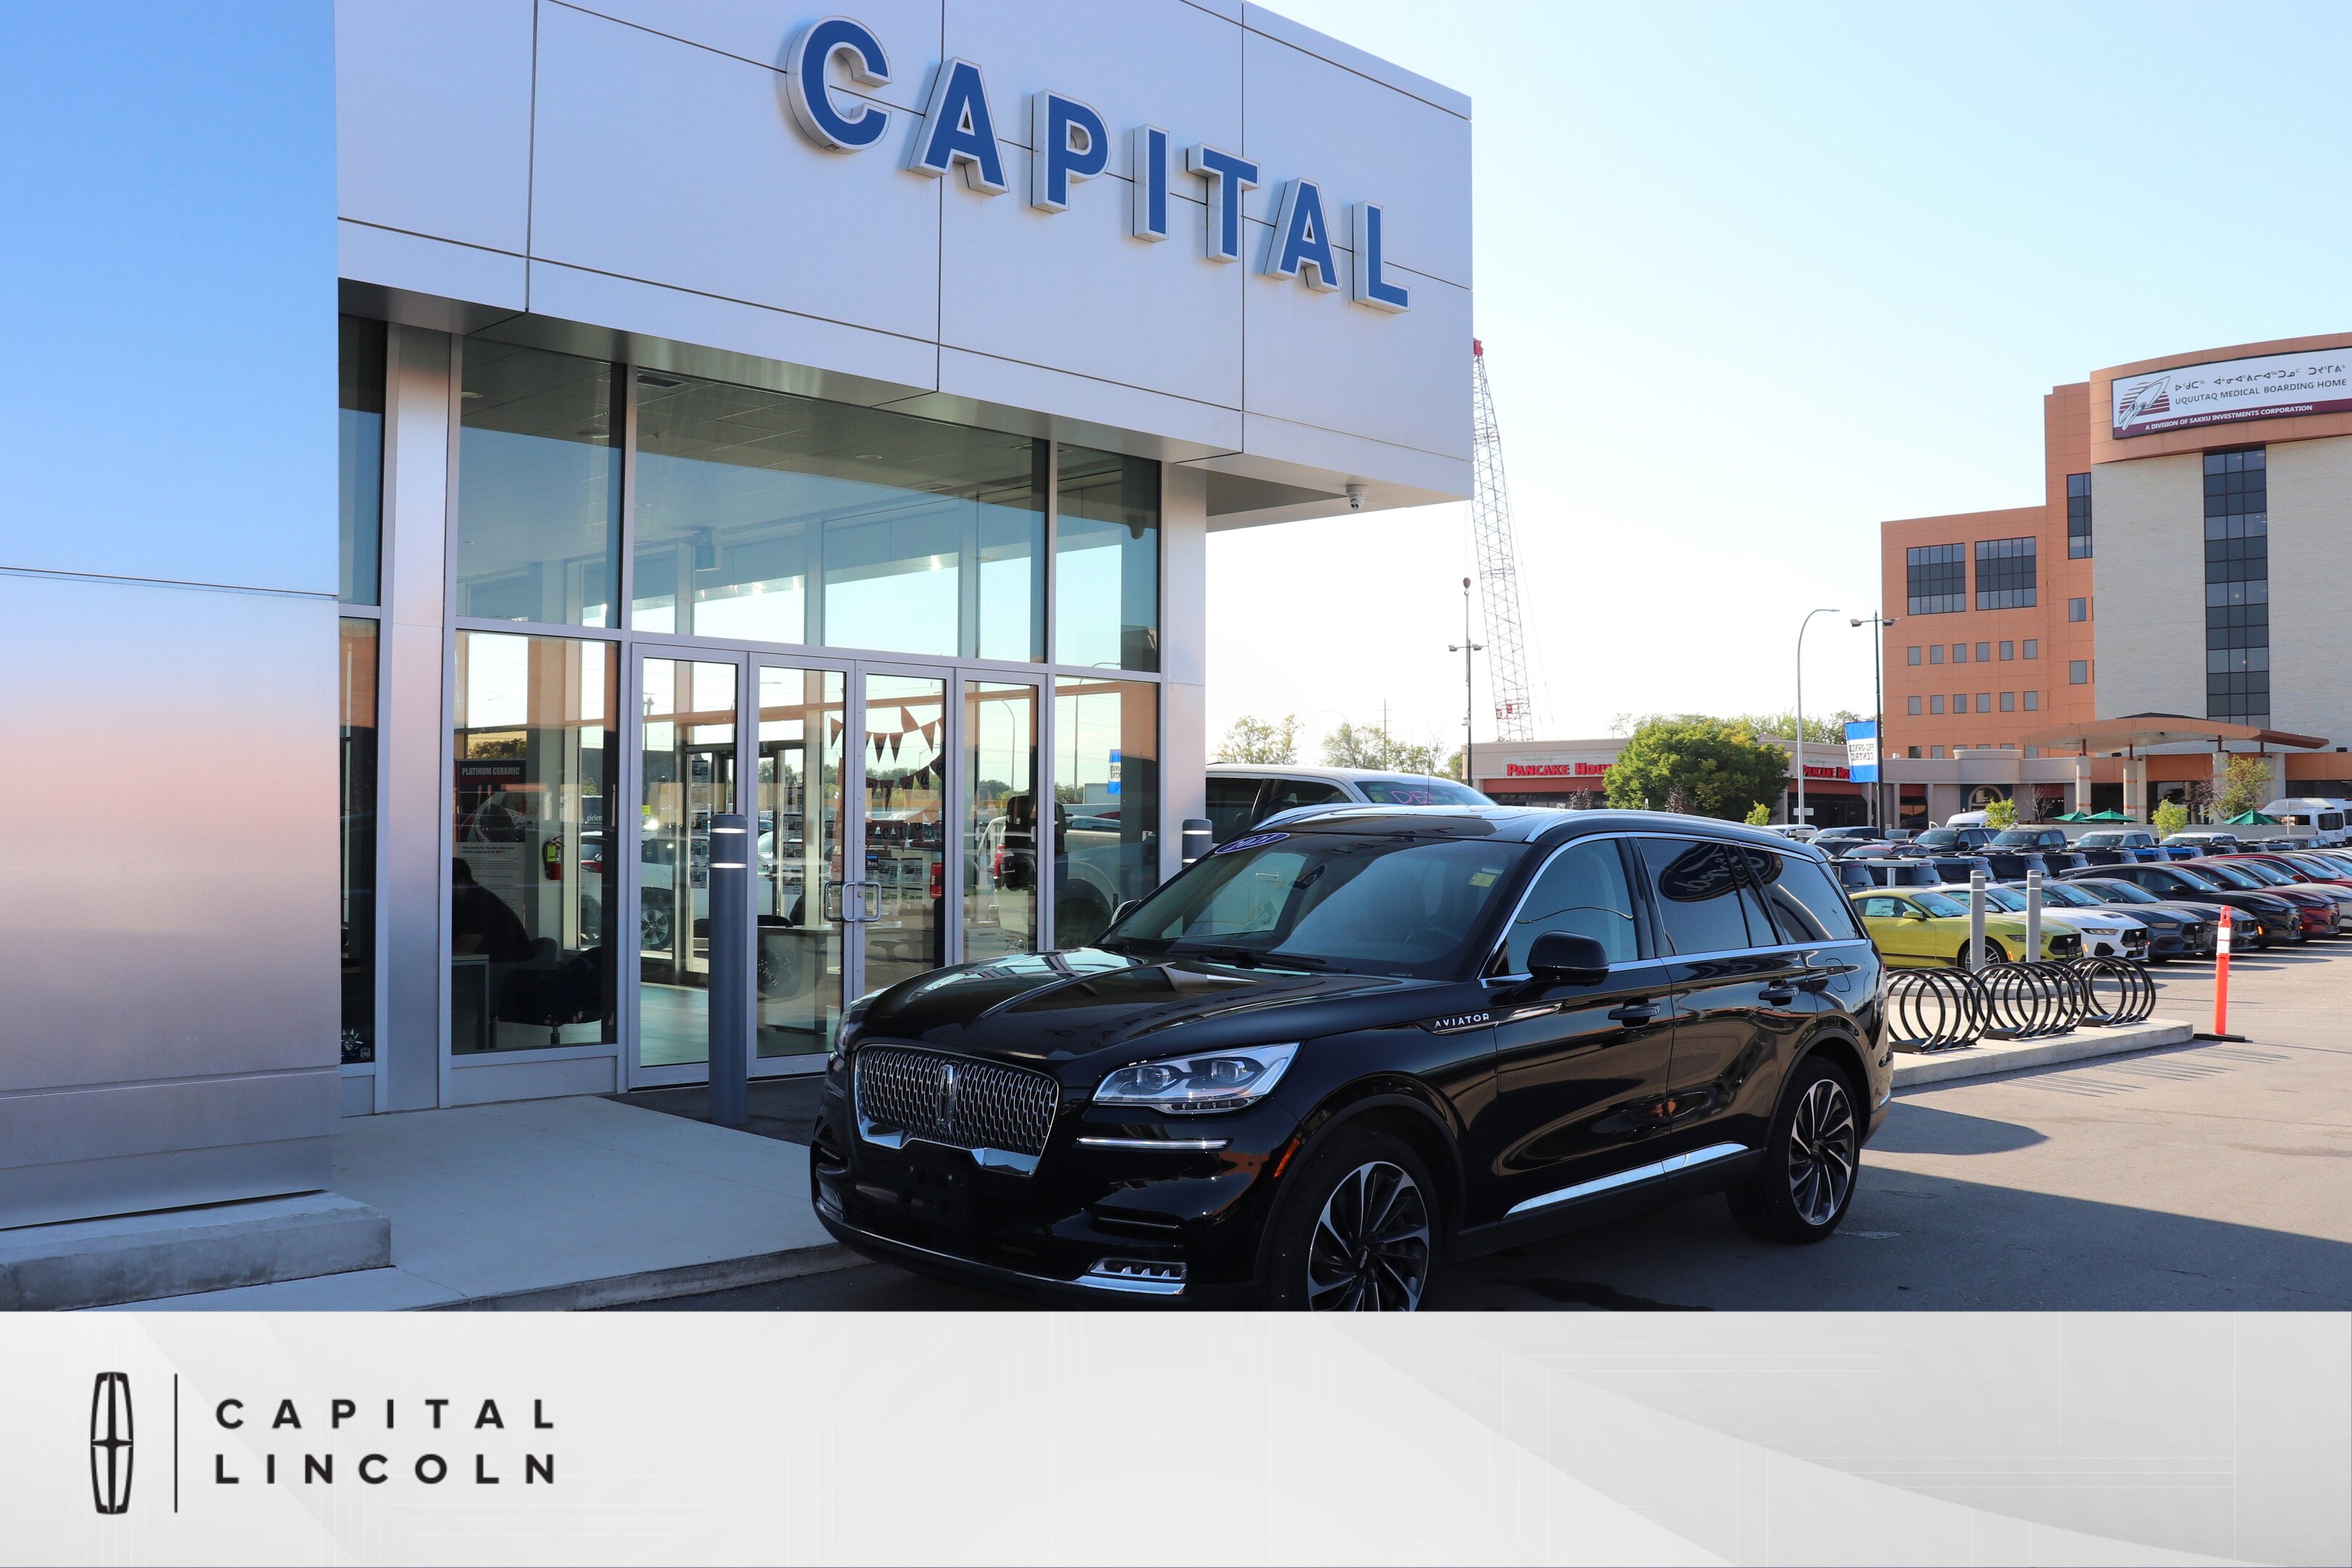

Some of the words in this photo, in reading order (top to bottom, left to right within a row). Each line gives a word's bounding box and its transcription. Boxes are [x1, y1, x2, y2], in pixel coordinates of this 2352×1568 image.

[787, 15, 1410, 313] CAPITAL
[2175, 392, 2218, 404] UQUUTAQ
[2220, 388, 2260, 399] MEDICAL
[2264, 382, 2314, 393] BOARDING
[2318, 378, 2347, 388] HOME
[2151, 420, 2179, 430] DIVISION
[2189, 415, 2211, 425] SAKKU
[2212, 409, 2259, 422] INVESTMENTS
[2261, 404, 2313, 416] CORPORATION
[1506, 764, 1570, 776] PANCAKE
[1575, 762, 1612, 775] HOU
[1836, 767, 1850, 779] HO
[1434, 1013, 1490, 1029] AVIATOR
